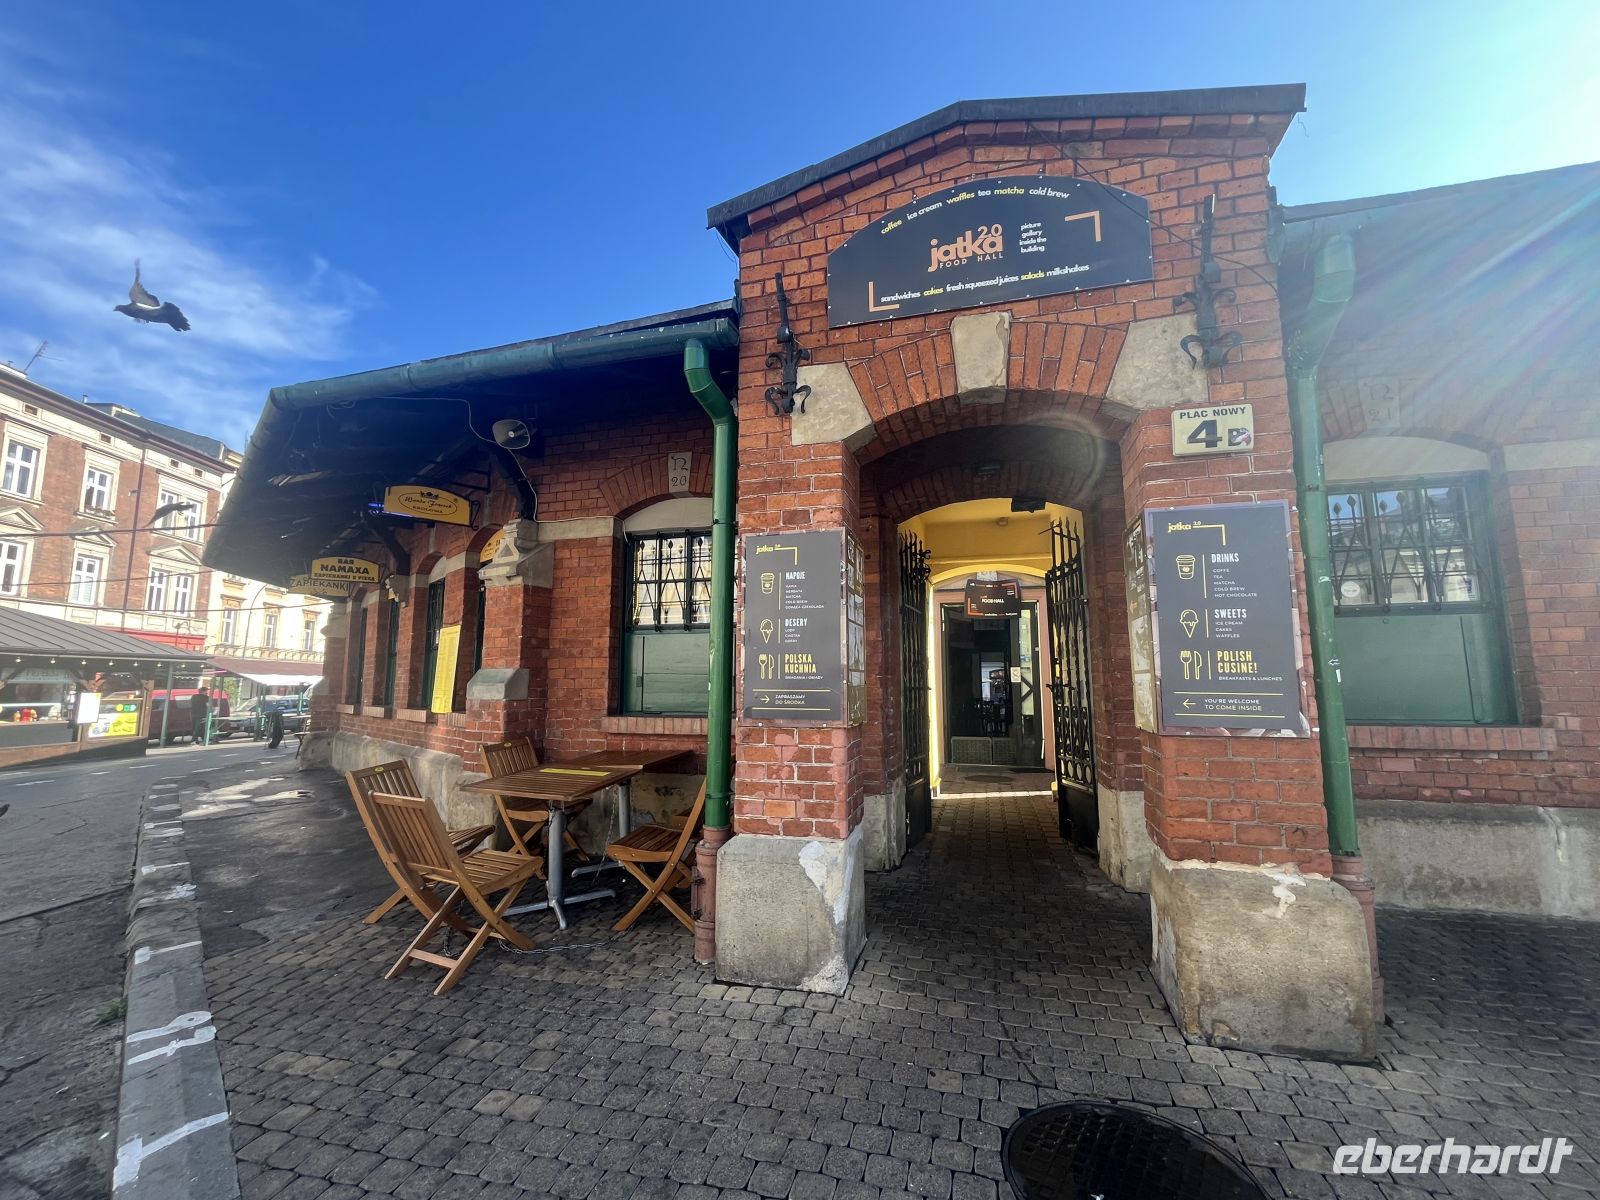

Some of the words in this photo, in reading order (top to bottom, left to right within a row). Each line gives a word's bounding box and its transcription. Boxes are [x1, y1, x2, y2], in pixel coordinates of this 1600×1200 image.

[881, 220, 902, 234] coffee
[906, 212, 918, 220] ice
[918, 202, 942, 215] cream
[946, 192, 975, 204] waffles
[994, 186, 1025, 194] matcha
[1029, 186, 1047, 196] cold
[1047, 188, 1070, 199] brew
[978, 224, 1002, 238] 2.0
[1020, 222, 1042, 231] picture
[1022, 230, 1042, 238] gallery
[928, 230, 1003, 272] jatka
[1020, 245, 1045, 253] building
[940, 258, 968, 269] FOOD
[978, 252, 1004, 262] HALL
[881, 291, 921, 302] sandwiches
[923, 287, 944, 296] cakes
[946, 282, 964, 292] fresh
[964, 276, 998, 290] squeezed
[998, 275, 1019, 286] juices
[1020, 270, 1045, 280] salads
[1046, 264, 1090, 276] milkshakes
[1180, 410, 1208, 420] PLAC
[1213, 407, 1246, 416] NOWY
[1186, 420, 1222, 448] 4
[672, 476, 686, 487] 20
[1168, 521, 1192, 533] jatka
[756, 545, 773, 554] jatka
[1211, 553, 1240, 563] DRINKS
[320, 564, 370, 574] NAMAXA
[785, 571, 806, 580] NAPOJE
[289, 579, 349, 591] ZAPIEKANKI
[1214, 608, 1247, 618] SWEETS
[785, 618, 808, 627] DESERY
[785, 653, 812, 663] POLSKA
[1217, 650, 1252, 661] POLISH
[785, 663, 817, 673] KUCHNIA
[1218, 662, 1258, 673] CUSINE!
